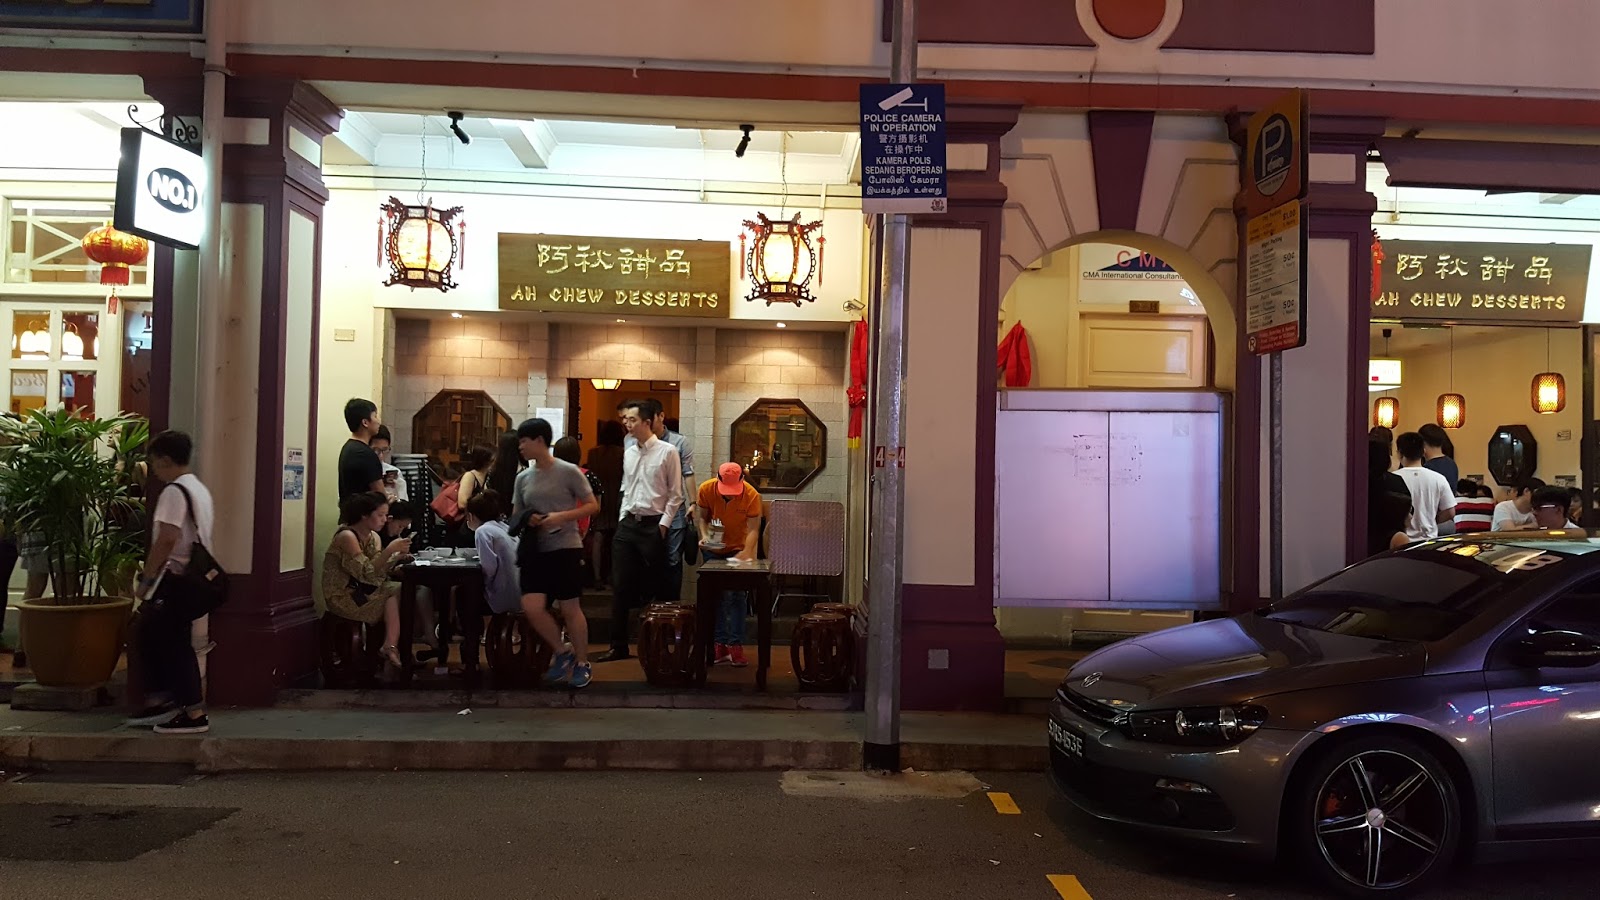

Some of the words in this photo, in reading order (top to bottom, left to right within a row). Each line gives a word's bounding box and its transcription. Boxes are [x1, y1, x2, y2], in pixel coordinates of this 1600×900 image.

[864, 114, 898, 122] POLICE
[901, 114, 942, 122] CAMERA
[870, 124, 879, 132] IN
[882, 124, 936, 132] OPERATION
[884, 145, 923, 154] 在操作中
[1262, 118, 1285, 177] P
[865, 166, 895, 175] SEDANG
[897, 166, 943, 175] BEROPERASI
[876, 157, 908, 165] KAMERA
[909, 157, 931, 165] POLIS
[151, 171, 195, 210] NO.1
[510, 285, 537, 302] AH
[549, 287, 604, 303] CHEW
[615, 289, 719, 309] DESSERTS
[1374, 291, 1400, 307] AH
[1410, 292, 1463, 308] CHEW
[1471, 293, 1567, 310] DESSERTS
[876, 446, 884, 467] 4
[898, 447, 905, 467] 4
